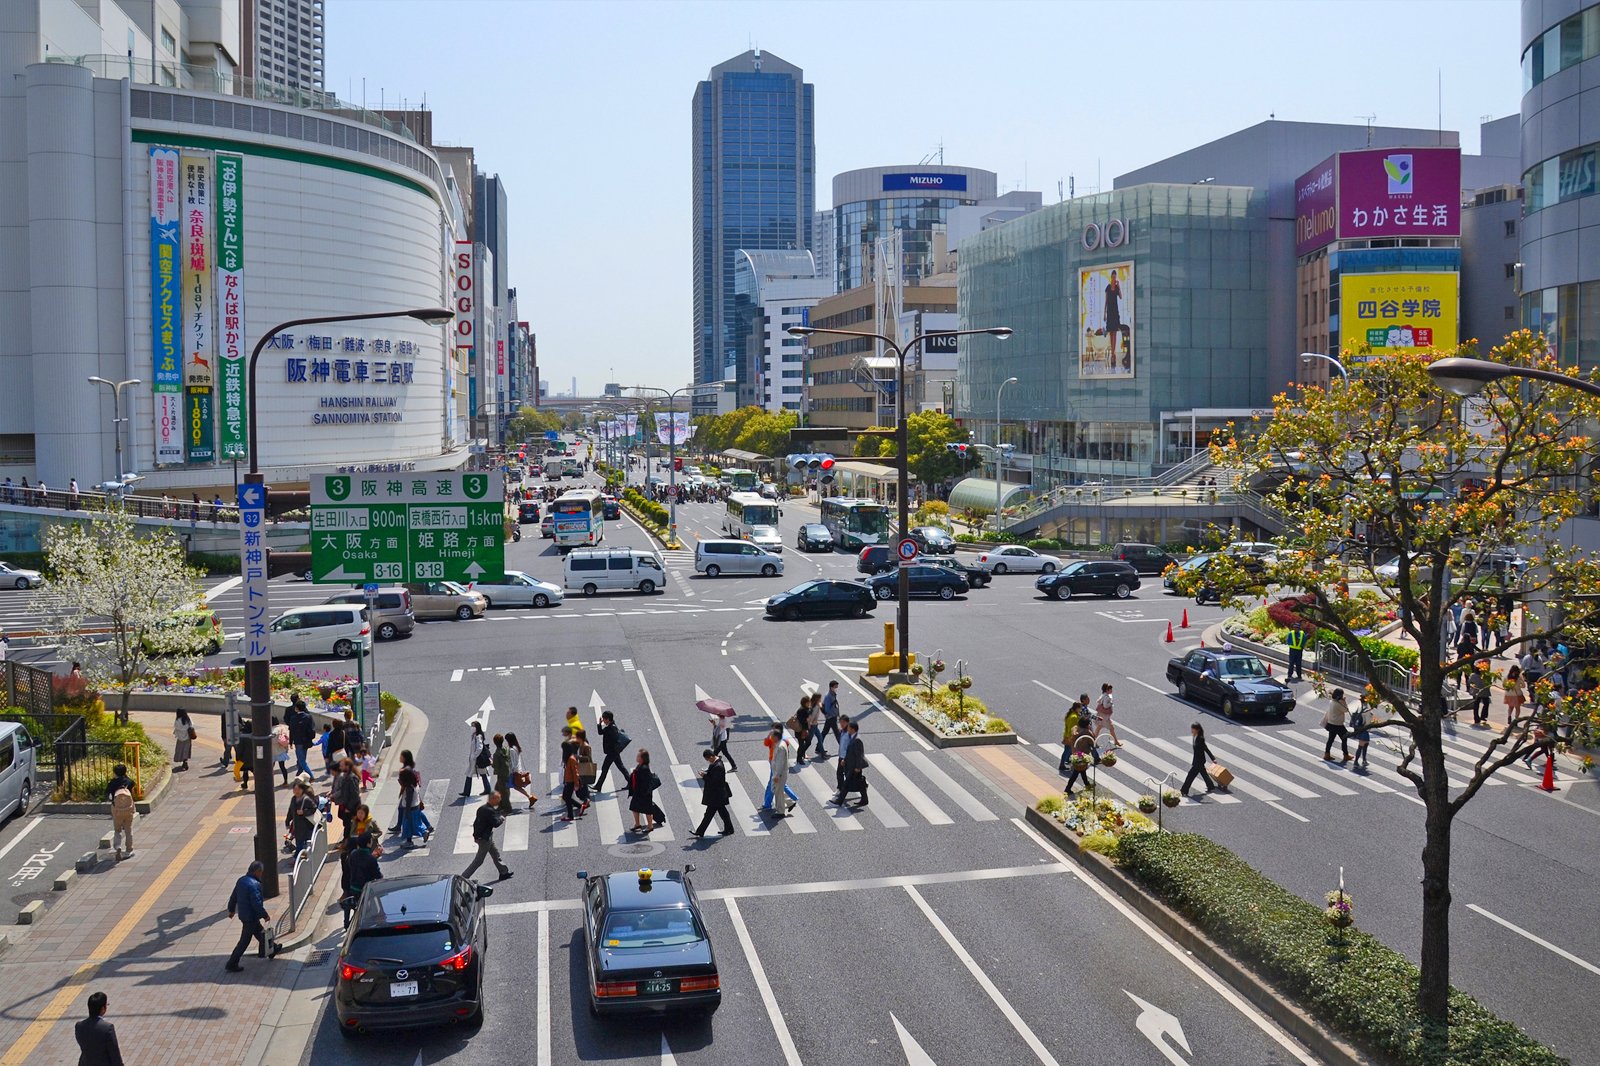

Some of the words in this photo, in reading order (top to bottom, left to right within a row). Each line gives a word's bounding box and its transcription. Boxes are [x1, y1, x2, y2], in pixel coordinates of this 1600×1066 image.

[910, 176, 943, 184] MIZUHO
[1353, 204, 1447, 228] わかさ生活
[457, 253, 472, 336] SOGO
[1358, 299, 1441, 319] 四谷学院
[287, 357, 414, 384] 阪神電車三宮駅
[320, 397, 363, 408] HANSHIN
[365, 397, 398, 407] RAILWAY
[314, 413, 371, 425] SANNOMIYA
[373, 412, 403, 423] STATION
[332, 479, 344, 495] 3
[361, 479, 452, 496] 阪神高速
[469, 477, 481, 493] 3
[246, 514, 258, 523] 32
[314, 511, 368, 528] 生田川入口
[372, 510, 405, 528] 900m
[411, 509, 466, 526] 京橋西行入口
[321, 533, 398, 550] 大阪方面
[418, 532, 495, 549] 姫路方面
[342, 550, 378, 560] Osaka
[439, 548, 475, 560] Himeji
[375, 564, 400, 577] 3-16
[417, 563, 442, 577] 3-18
[244, 530, 267, 657] 新神戸トンネル
